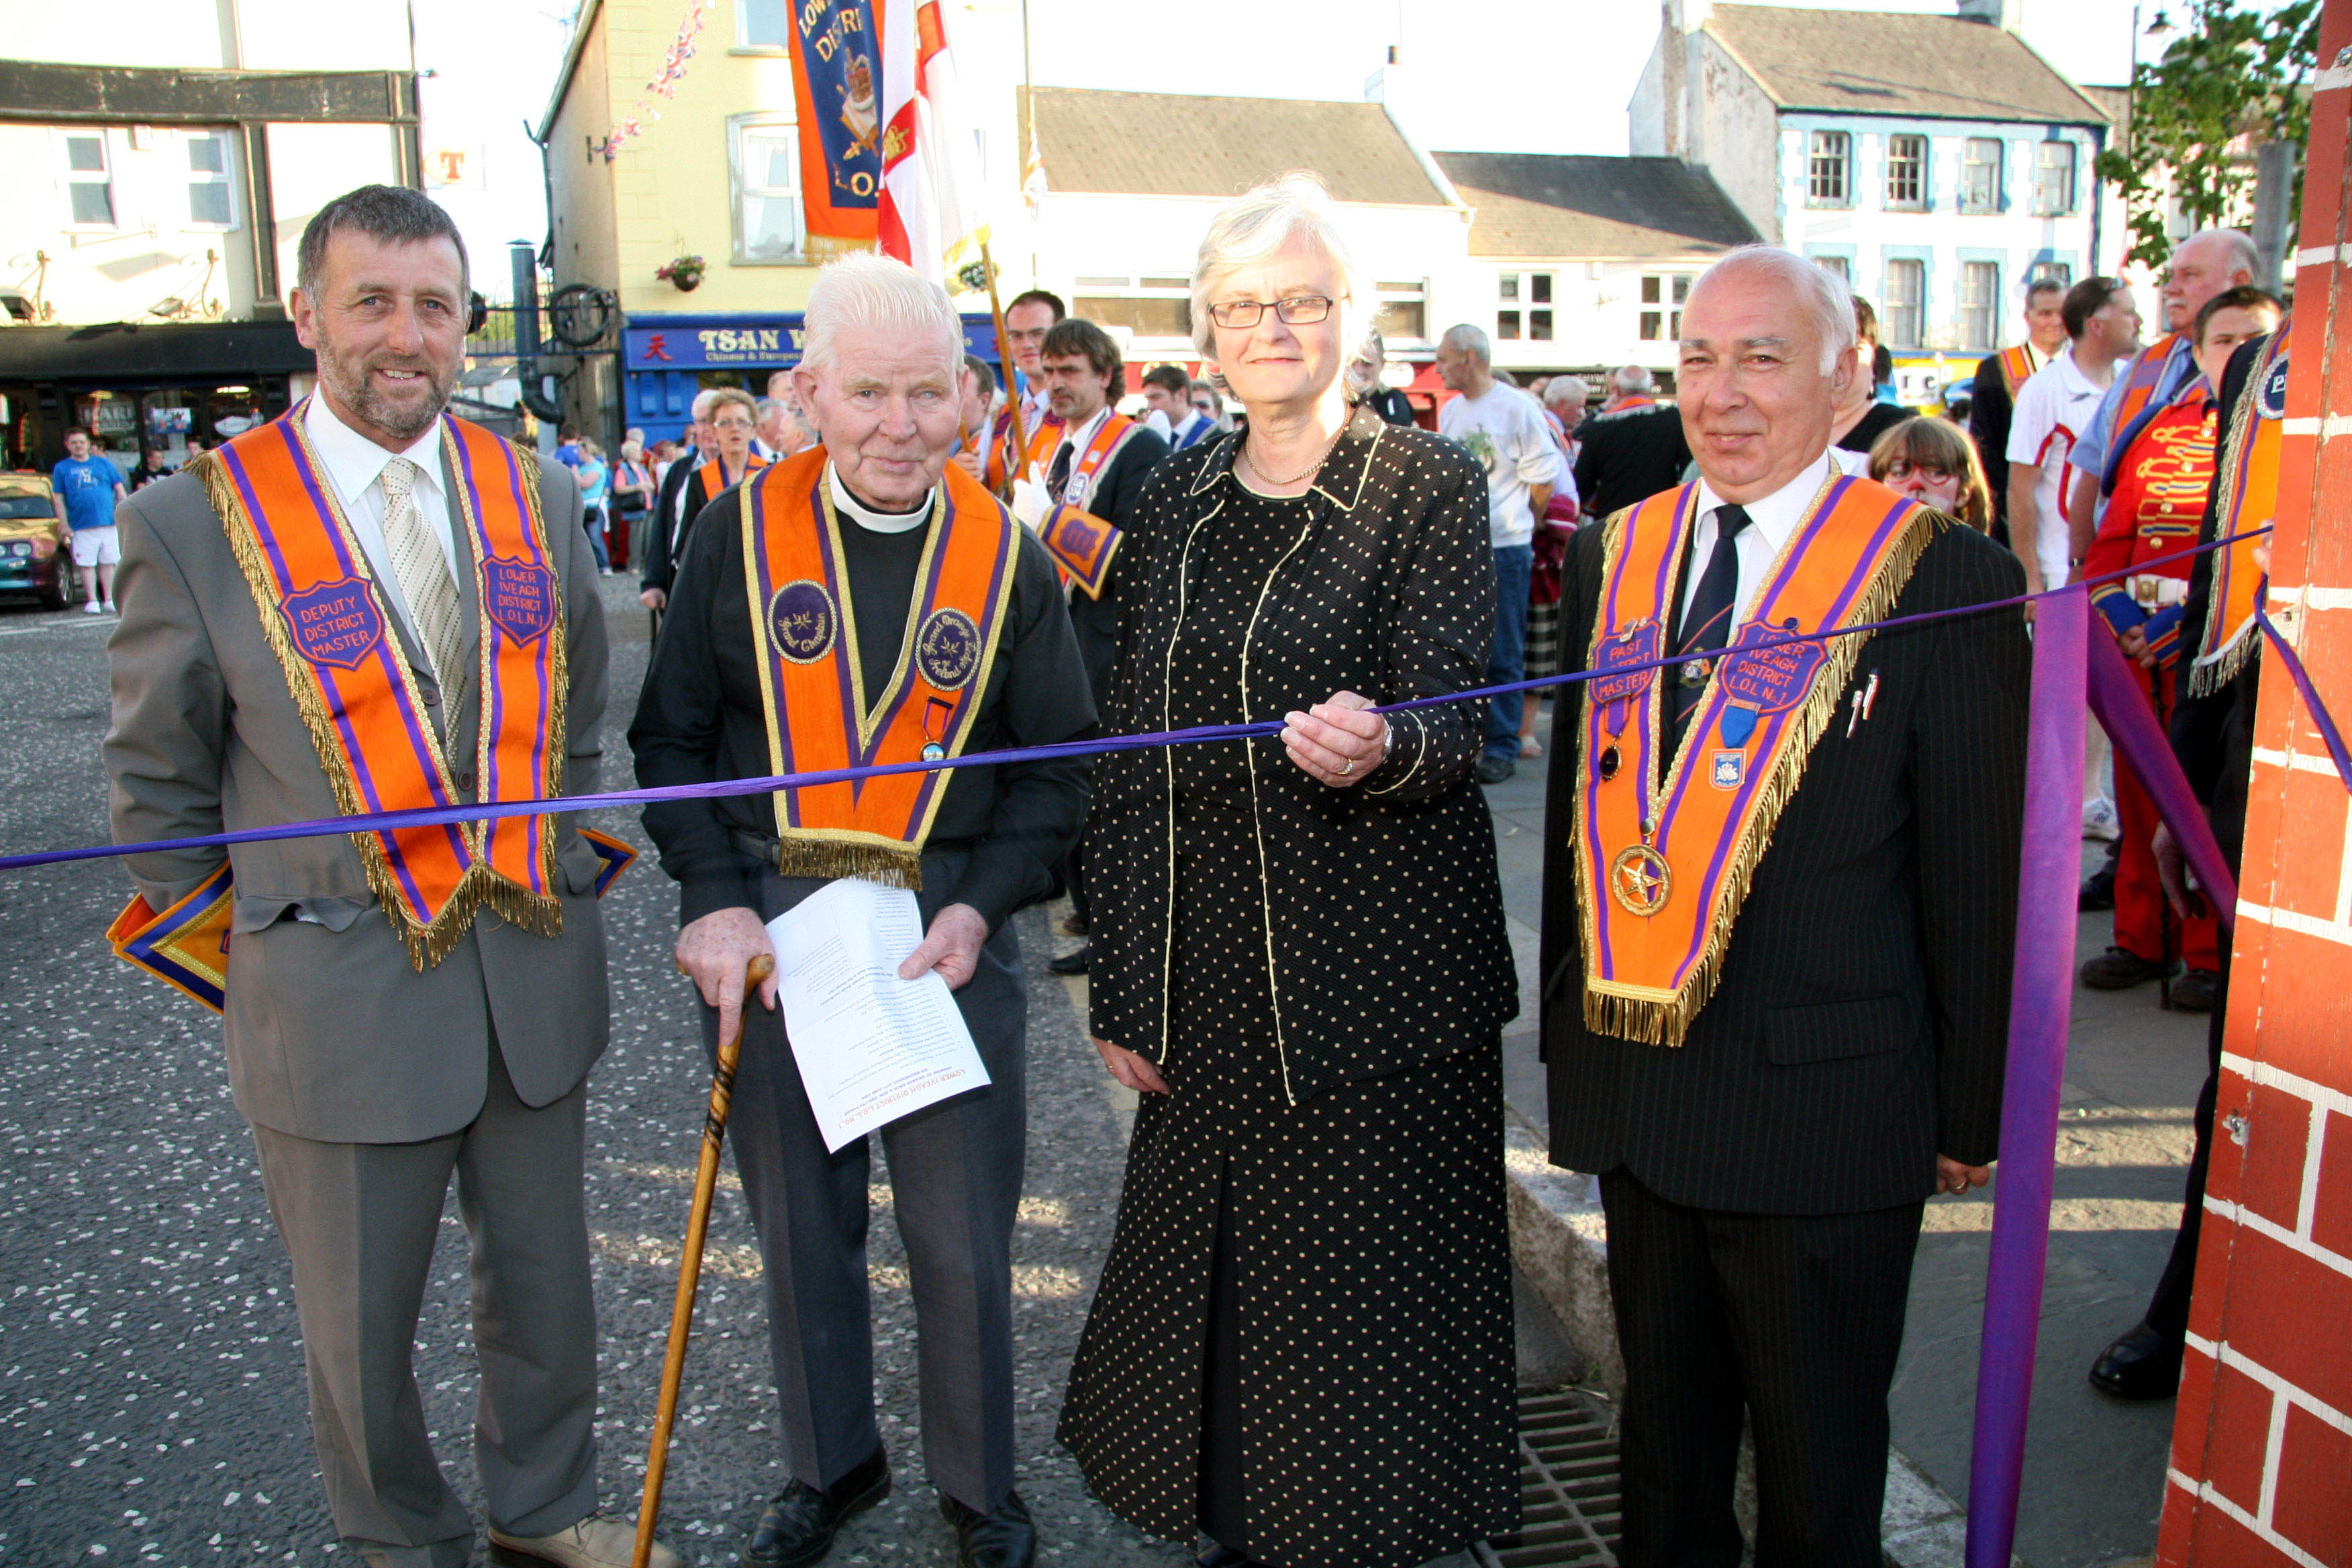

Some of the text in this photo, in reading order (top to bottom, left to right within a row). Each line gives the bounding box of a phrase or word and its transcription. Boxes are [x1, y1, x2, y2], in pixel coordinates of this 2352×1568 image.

[440, 152, 464, 180] T
[698, 330, 781, 352] TSAN
[499, 568, 536, 583] LOWER
[499, 581, 540, 597] IVEAGH
[300, 595, 356, 623] DEPUTY
[499, 594, 541, 612] DISTRICT
[304, 612, 364, 642] DISTRICT
[311, 630, 371, 658] MASTER
[1610, 638, 1643, 660] PAST
[1749, 648, 1799, 674] IVEAGH
[1599, 671, 1649, 699] MASTER
[1737, 660, 1794, 689] DISTRICT
[911, 1076, 939, 1093] IVEAGH
[941, 1069, 966, 1082] LOWER
[877, 1091, 910, 1108] DISTRICT
